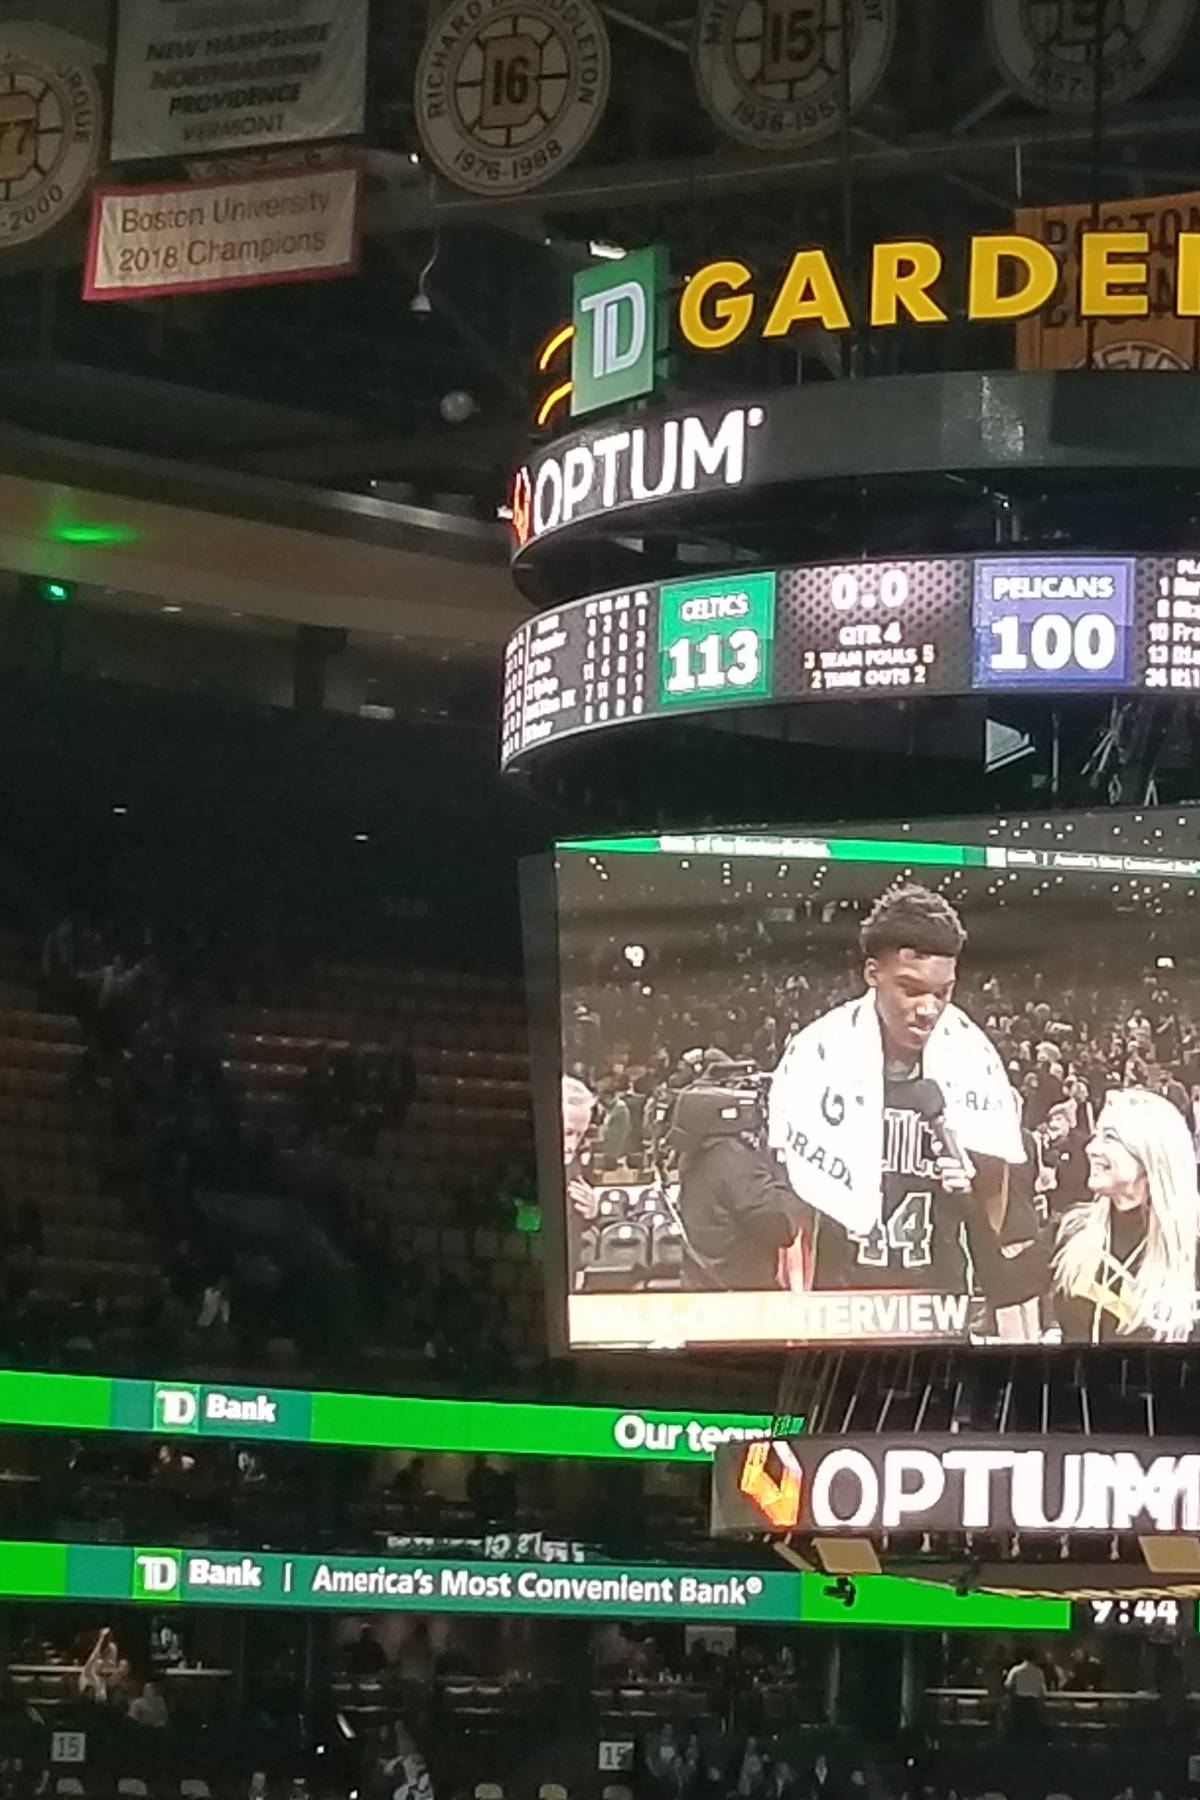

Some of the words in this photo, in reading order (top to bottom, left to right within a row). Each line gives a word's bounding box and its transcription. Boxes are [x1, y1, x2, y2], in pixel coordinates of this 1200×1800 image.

[772, 9, 814, 63] 15
[493, 55, 528, 105] 16
[183, 113, 286, 141] VERMONT
[453, 139, 562, 179] 1976-1988
[120, 206, 205, 234] Boston
[212, 191, 331, 224] University
[119, 247, 179, 272] 2018
[187, 230, 326, 265] Champions
[581, 281, 645, 376] TD
[680, 593, 749, 622] CELTICS
[832, 569, 908, 610] 0.0
[993, 576, 1115, 600] PELICANS
[840, 625, 882, 645] QTR
[883, 621, 902, 643] 4
[990, 613, 1116, 671] 100
[667, 629, 758, 693] 113
[811, 670, 822, 688] 2
[865, 668, 910, 685] OUTS
[914, 665, 926, 683] 2
[865, 648, 918, 666] FOULS
[156, 1389, 197, 1424] TD
[206, 1393, 277, 1423] Bank
[614, 1414, 683, 1449] Our
[136, 1556, 177, 1592] TD
[189, 1558, 262, 1587] Bank
[312, 1565, 434, 1595] America's
[441, 1569, 511, 1598] Most
[518, 1572, 673, 1602] Convenient
[58, 1736, 80, 1758] 15
